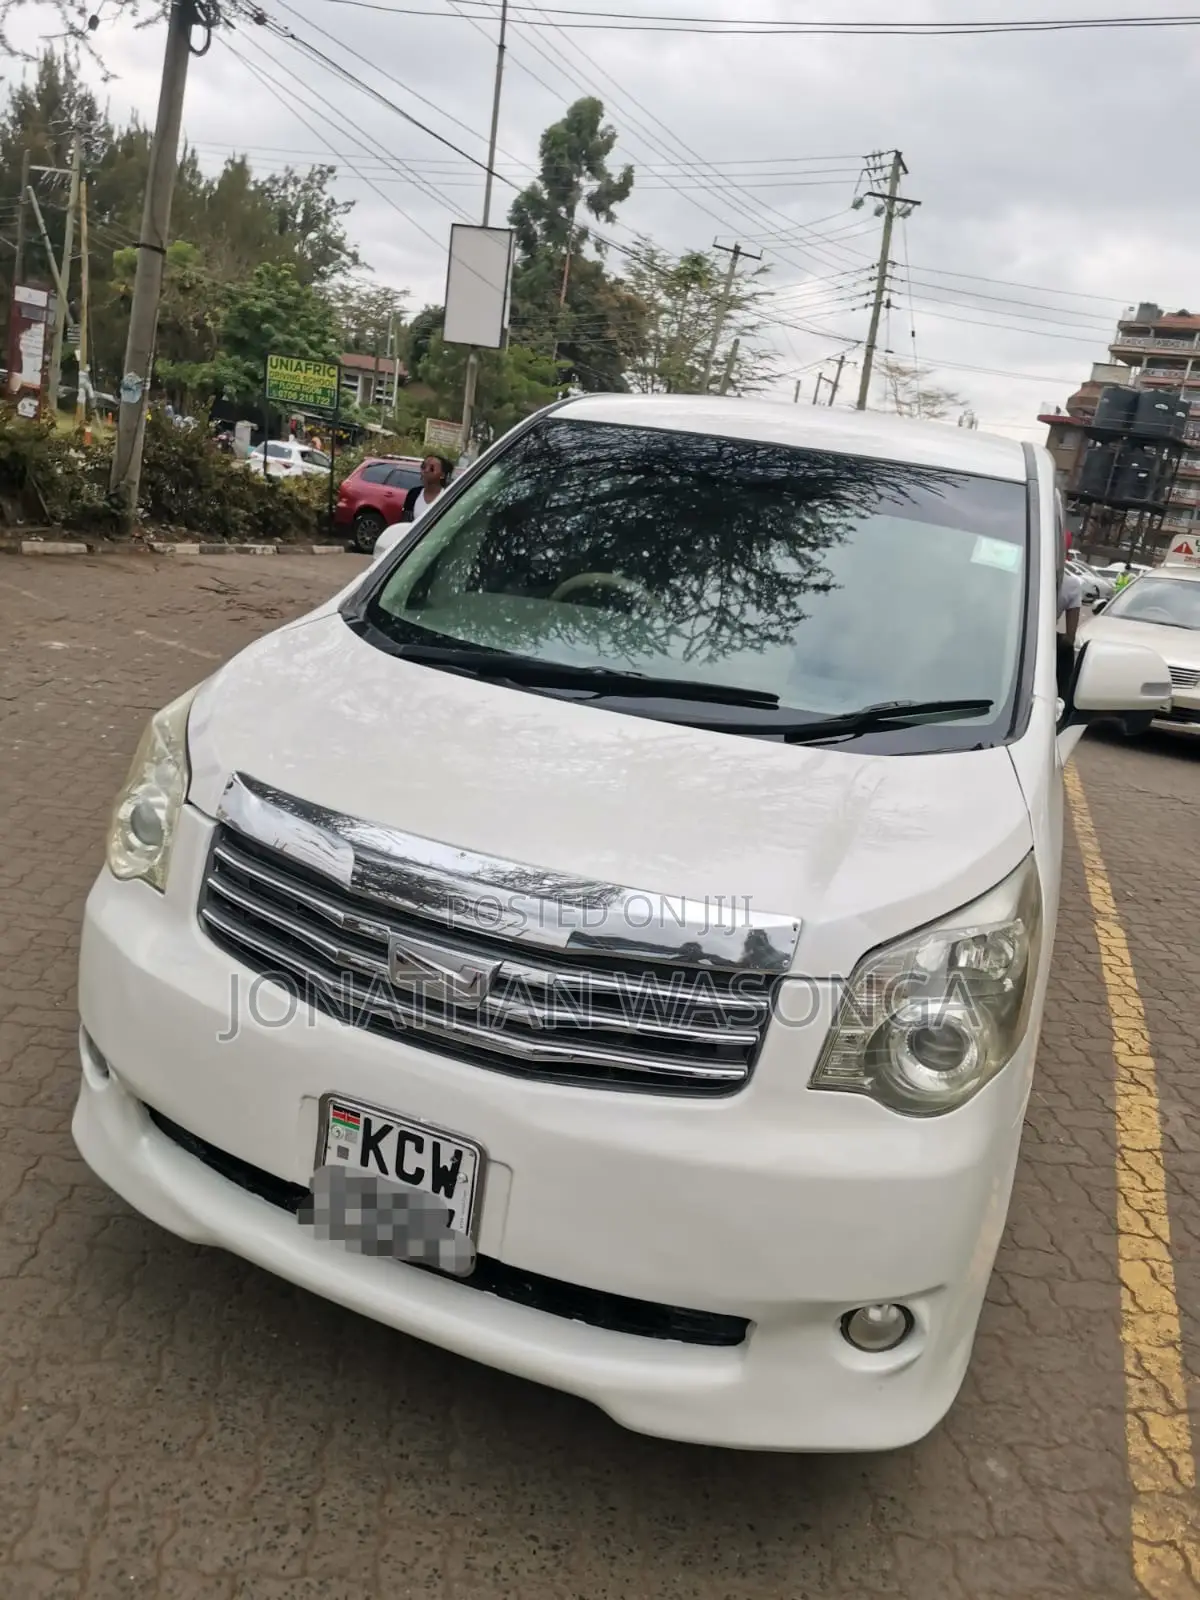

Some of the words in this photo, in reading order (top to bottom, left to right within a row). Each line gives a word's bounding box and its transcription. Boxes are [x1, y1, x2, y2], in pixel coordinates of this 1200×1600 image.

[269, 356, 336, 378] UNIAFRIC
[269, 370, 300, 383] DRIVING
[302, 375, 335, 388] SCHOOL
[360, 1116, 464, 1200] KCW
